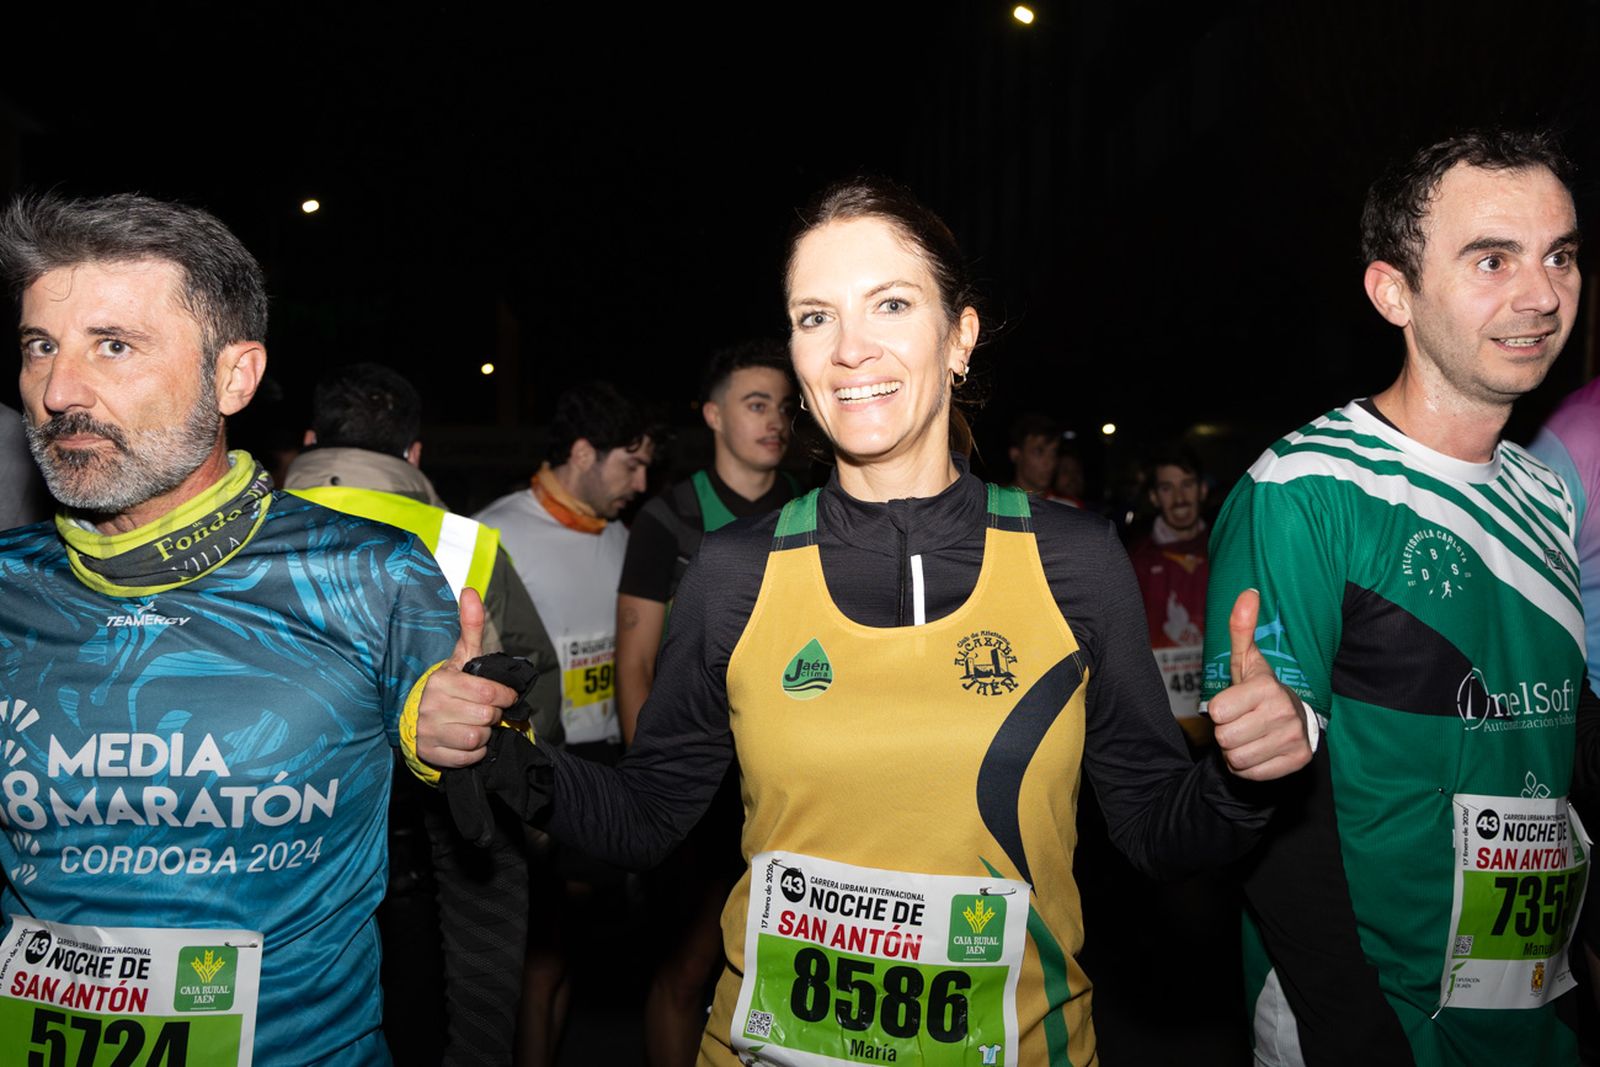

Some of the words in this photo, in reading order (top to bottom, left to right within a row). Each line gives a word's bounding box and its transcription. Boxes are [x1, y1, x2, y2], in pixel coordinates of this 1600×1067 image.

[153, 508, 242, 562] Fondo
[784, 658, 830, 682] Jaén
[800, 670, 828, 678] clima
[48, 733, 230, 777] MEDIA
[0, 770, 48, 830] 8
[50, 770, 339, 828] MARATÓN
[1477, 816, 1499, 832] 43
[1503, 822, 1556, 842] NOCHE
[246, 836, 324, 873] 2024
[1476, 847, 1518, 870] SAN
[1519, 843, 1568, 870] ANTÓN
[766, 863, 775, 883] 2026
[780, 875, 805, 894] 43
[765, 884, 773, 895] de
[810, 876, 839, 890] CARRERA
[840, 883, 869, 894] URBANA
[869, 888, 925, 901] INTERNACIONAL
[763, 896, 771, 919] Enero
[809, 887, 887, 921] NOCHE
[892, 901, 925, 926] DE
[761, 920, 769, 929] 17
[778, 910, 827, 944] SAN
[830, 924, 923, 961] ANTÓN
[28, 937, 50, 955] 43
[98, 945, 151, 957] INTERNACIONAL
[953, 936, 972, 945] CAJA
[974, 936, 999, 946] RURAL
[965, 944, 986, 955] JAÉN
[46, 947, 114, 979] NOCHE
[119, 957, 152, 980] DE
[10, 970, 61, 1003] SAN
[59, 980, 149, 1013] ANTÓN
[180, 986, 200, 995] CAJA
[202, 985, 230, 995] RURAL
[193, 995, 215, 1005] JAÉN
[790, 947, 972, 1043] 8586
[27, 1007, 191, 1067] 5724
[850, 1038, 897, 1063] María
